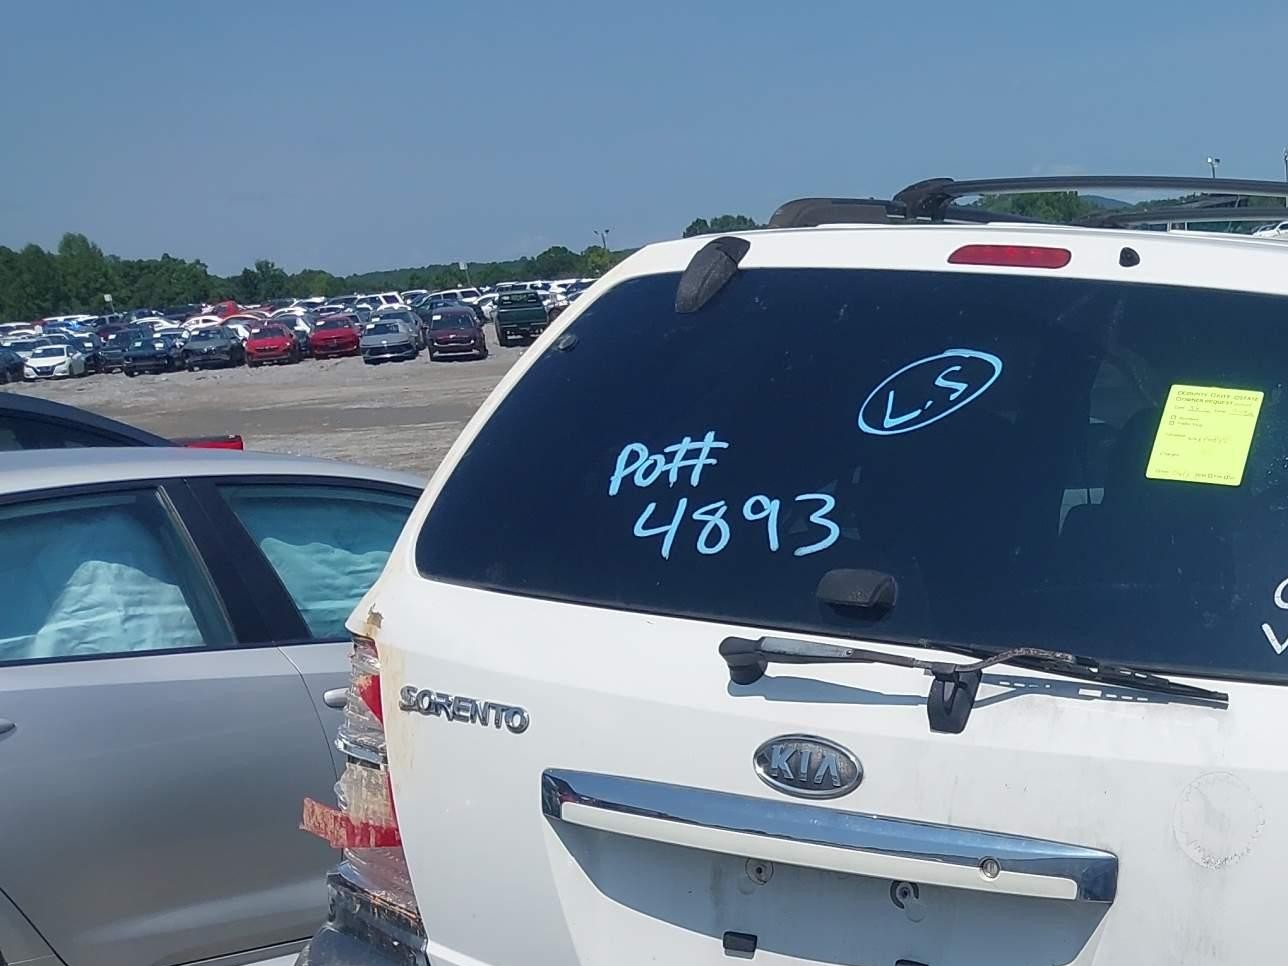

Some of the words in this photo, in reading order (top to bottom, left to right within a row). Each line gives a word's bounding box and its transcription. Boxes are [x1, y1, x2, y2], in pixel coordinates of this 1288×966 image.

[633, 493, 841, 560] 4893
[399, 685, 530, 735] SORENTO
[769, 744, 841, 787] KIA
